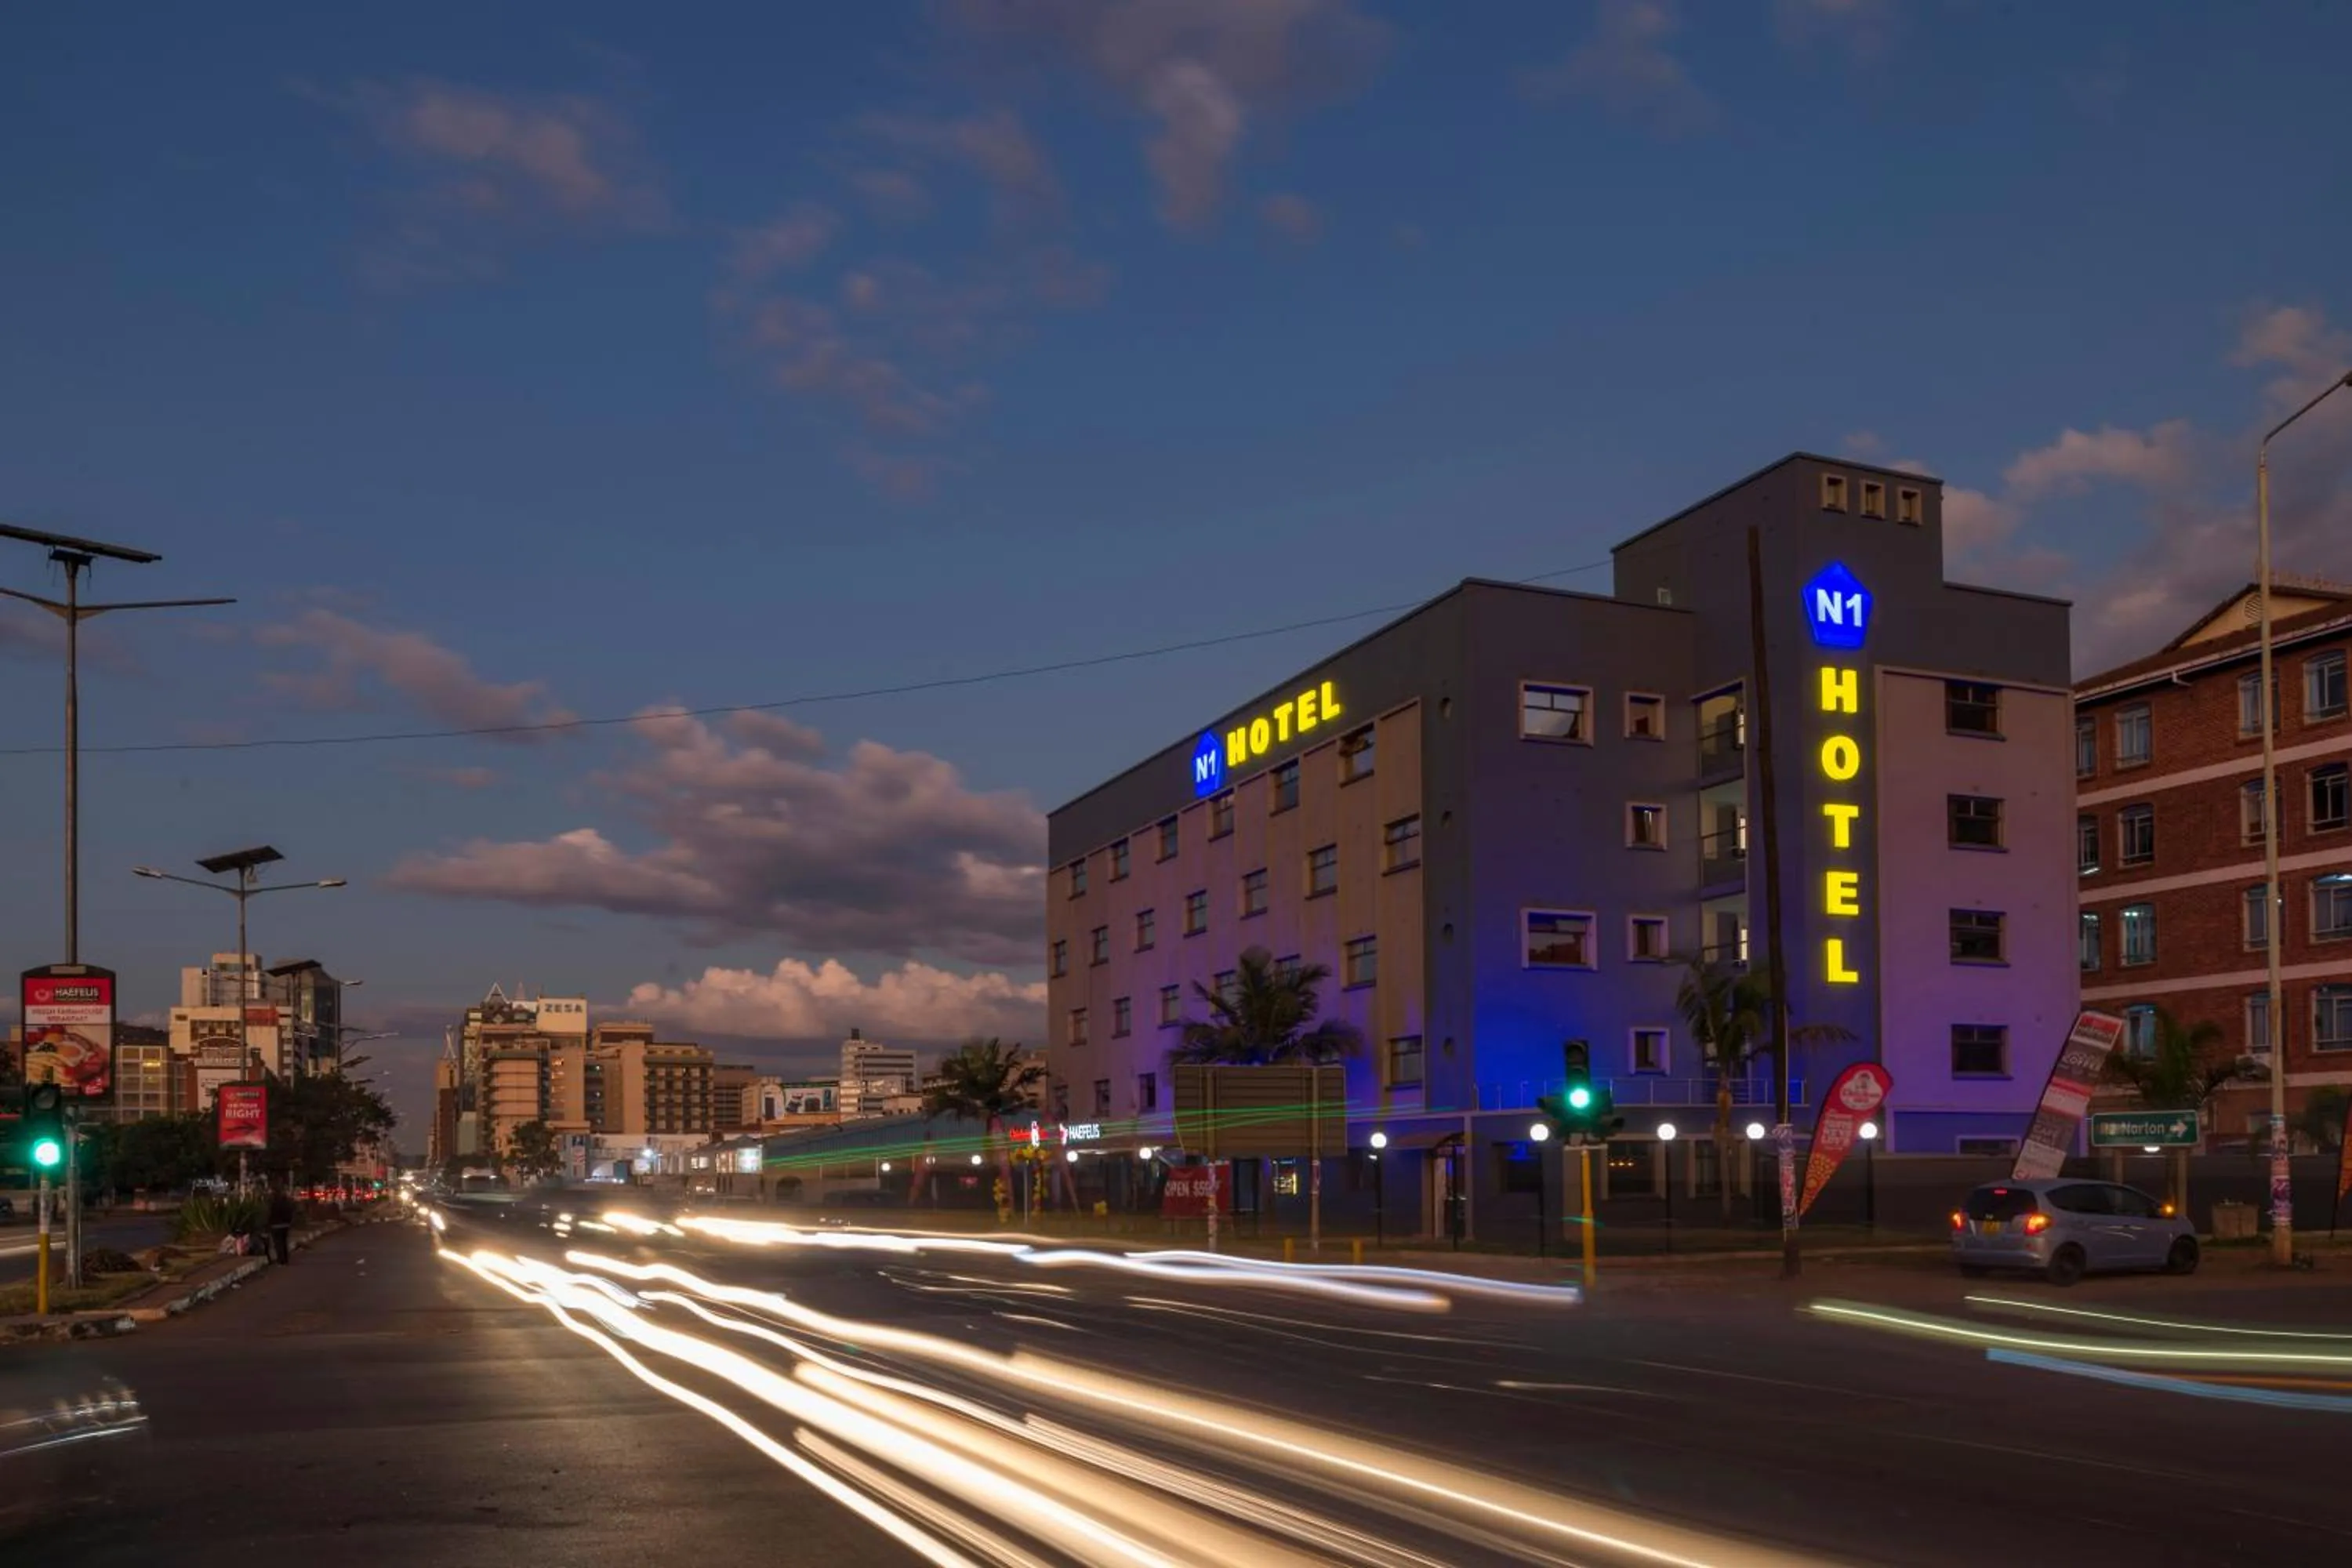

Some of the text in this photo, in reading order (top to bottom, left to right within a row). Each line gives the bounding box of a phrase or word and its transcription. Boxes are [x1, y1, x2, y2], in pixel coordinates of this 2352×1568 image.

[1816, 589, 1864, 627] N1
[1195, 681, 1341, 783] N1 HOTEL
[1820, 666, 1860, 983] HOTEL
[544, 1003, 583, 1013] ZESA
[225, 1109, 261, 1119] RIGHT
[2121, 1121, 2165, 1135] Norton
[1165, 1180, 1189, 1197] OPEN
